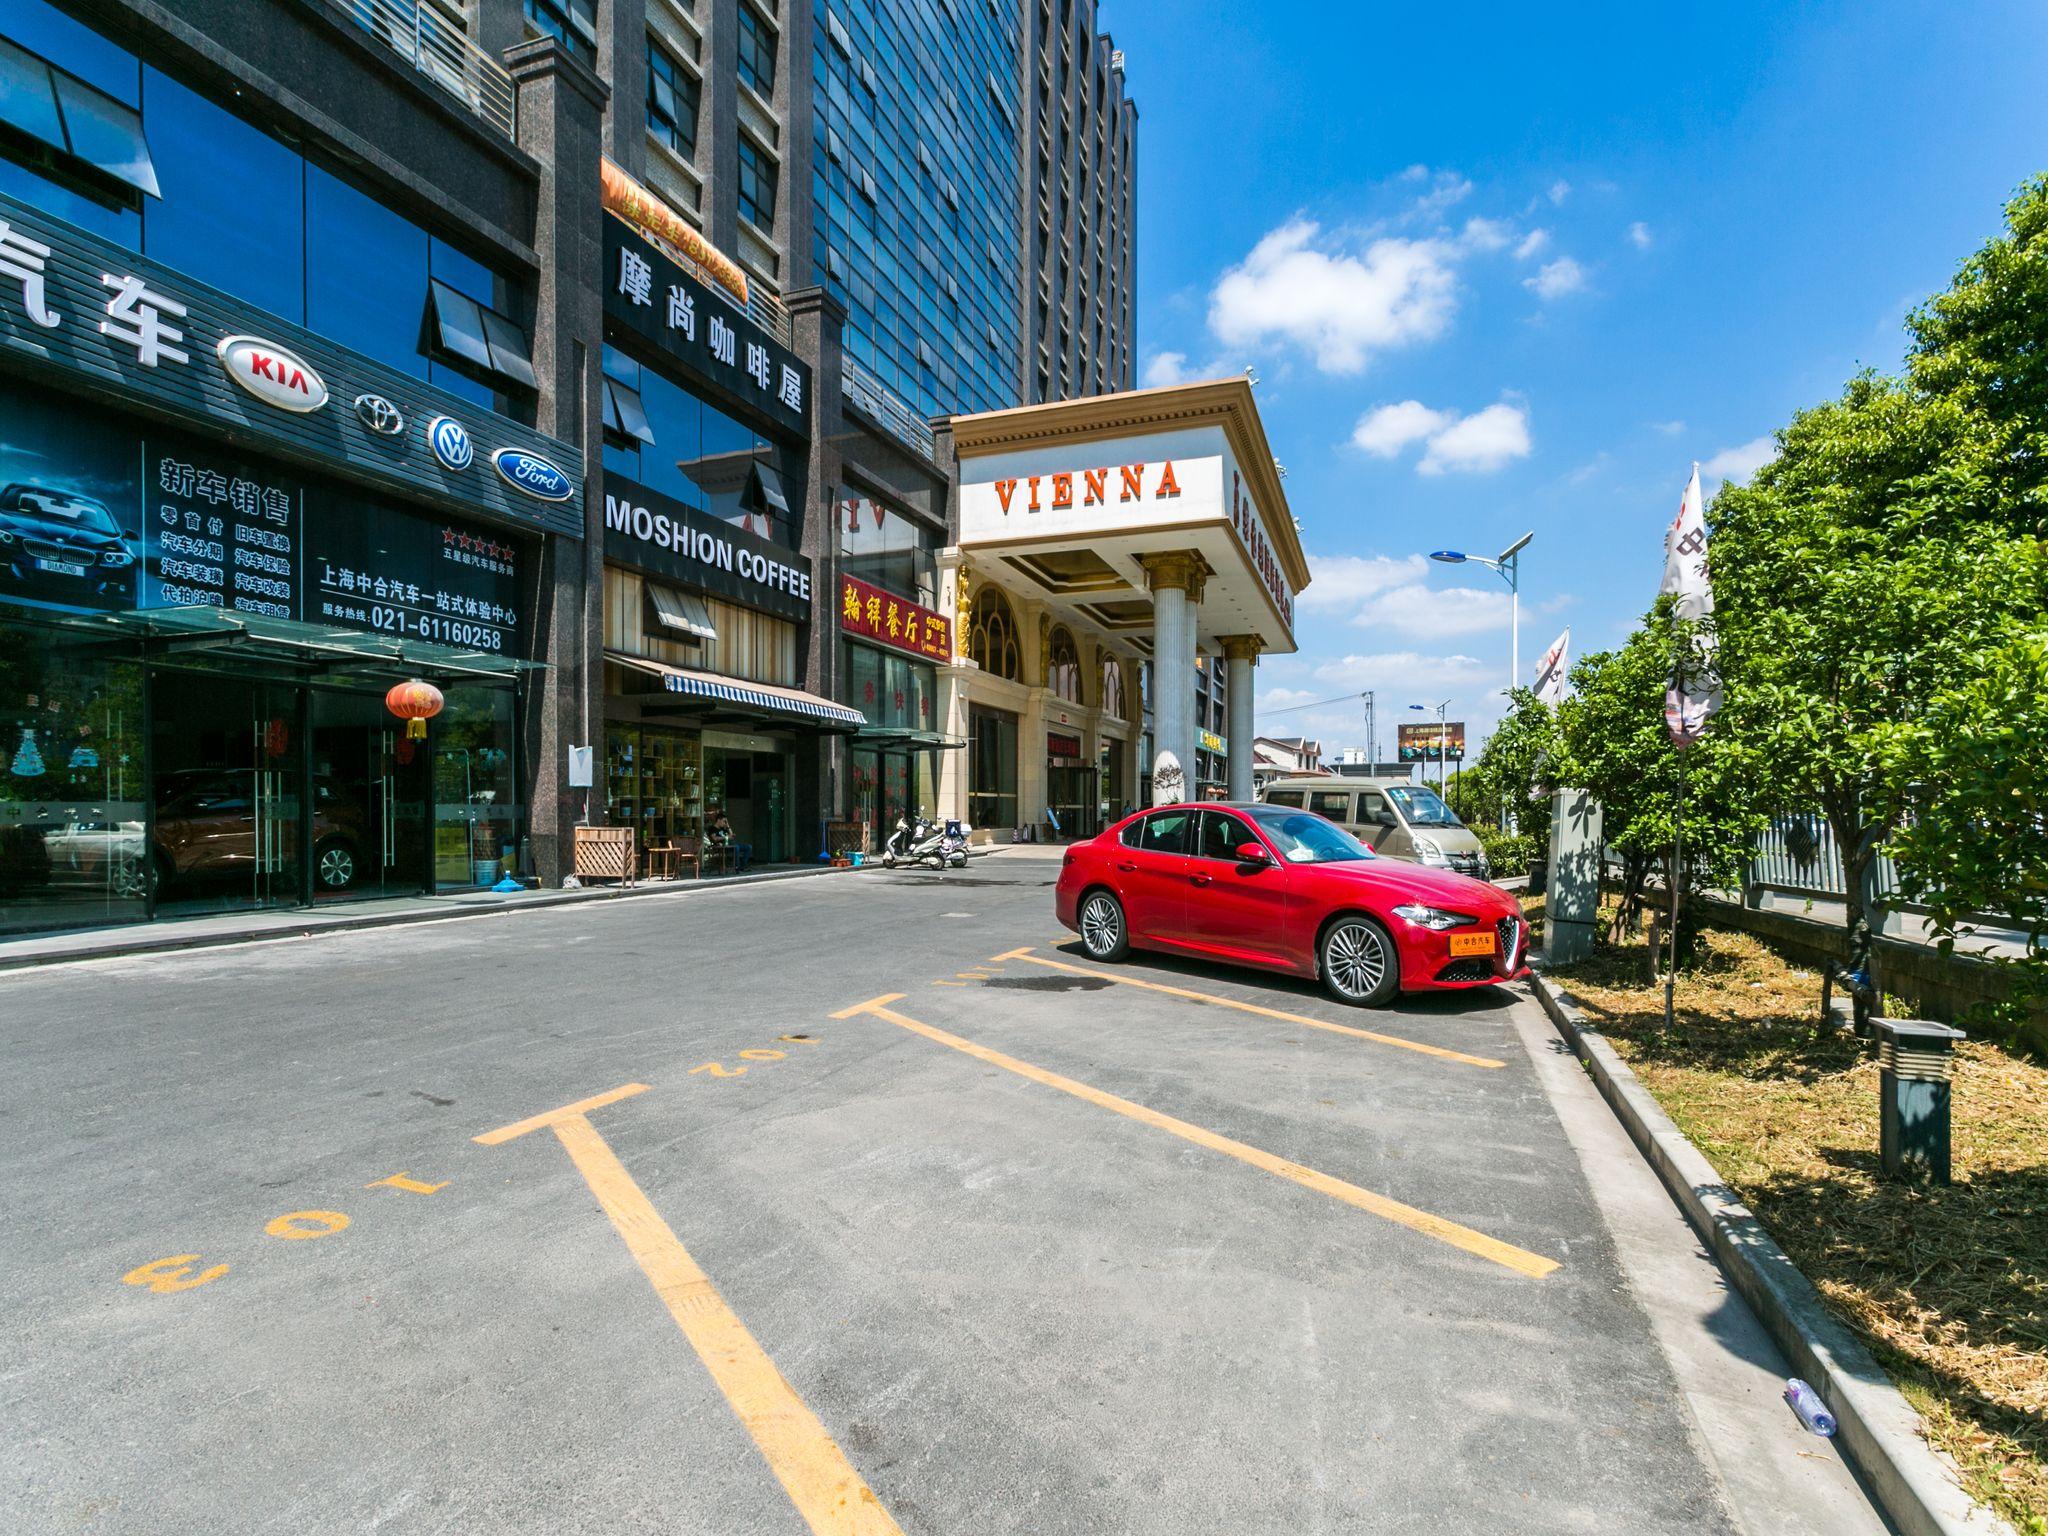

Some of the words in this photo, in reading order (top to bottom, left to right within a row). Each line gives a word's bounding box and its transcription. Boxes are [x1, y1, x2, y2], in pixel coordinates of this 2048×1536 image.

[618, 246, 802, 414] 摩尚咖啡屋
[250, 351, 309, 395] KIA
[160, 457, 290, 523] 新车销售
[514, 457, 559, 491] Ford
[995, 459, 1182, 514] VIENNA
[160, 504, 224, 536] 零首付
[235, 523, 291, 553] 旧车置换
[160, 530, 224, 562] 汽车分期
[234, 547, 291, 576] 汽车保险
[443, 546, 515, 577] 五星级汽车服务商
[606, 493, 733, 573] MOSHION
[735, 548, 811, 601] COFFEE
[234, 572, 291, 600] 汽车改装
[320, 564, 518, 626] 上海中合汽车一站式体验中心
[234, 596, 291, 619] 汽车租赁
[843, 583, 918, 643] 翰祥餐厅
[371, 605, 502, 650] 021-61160258
